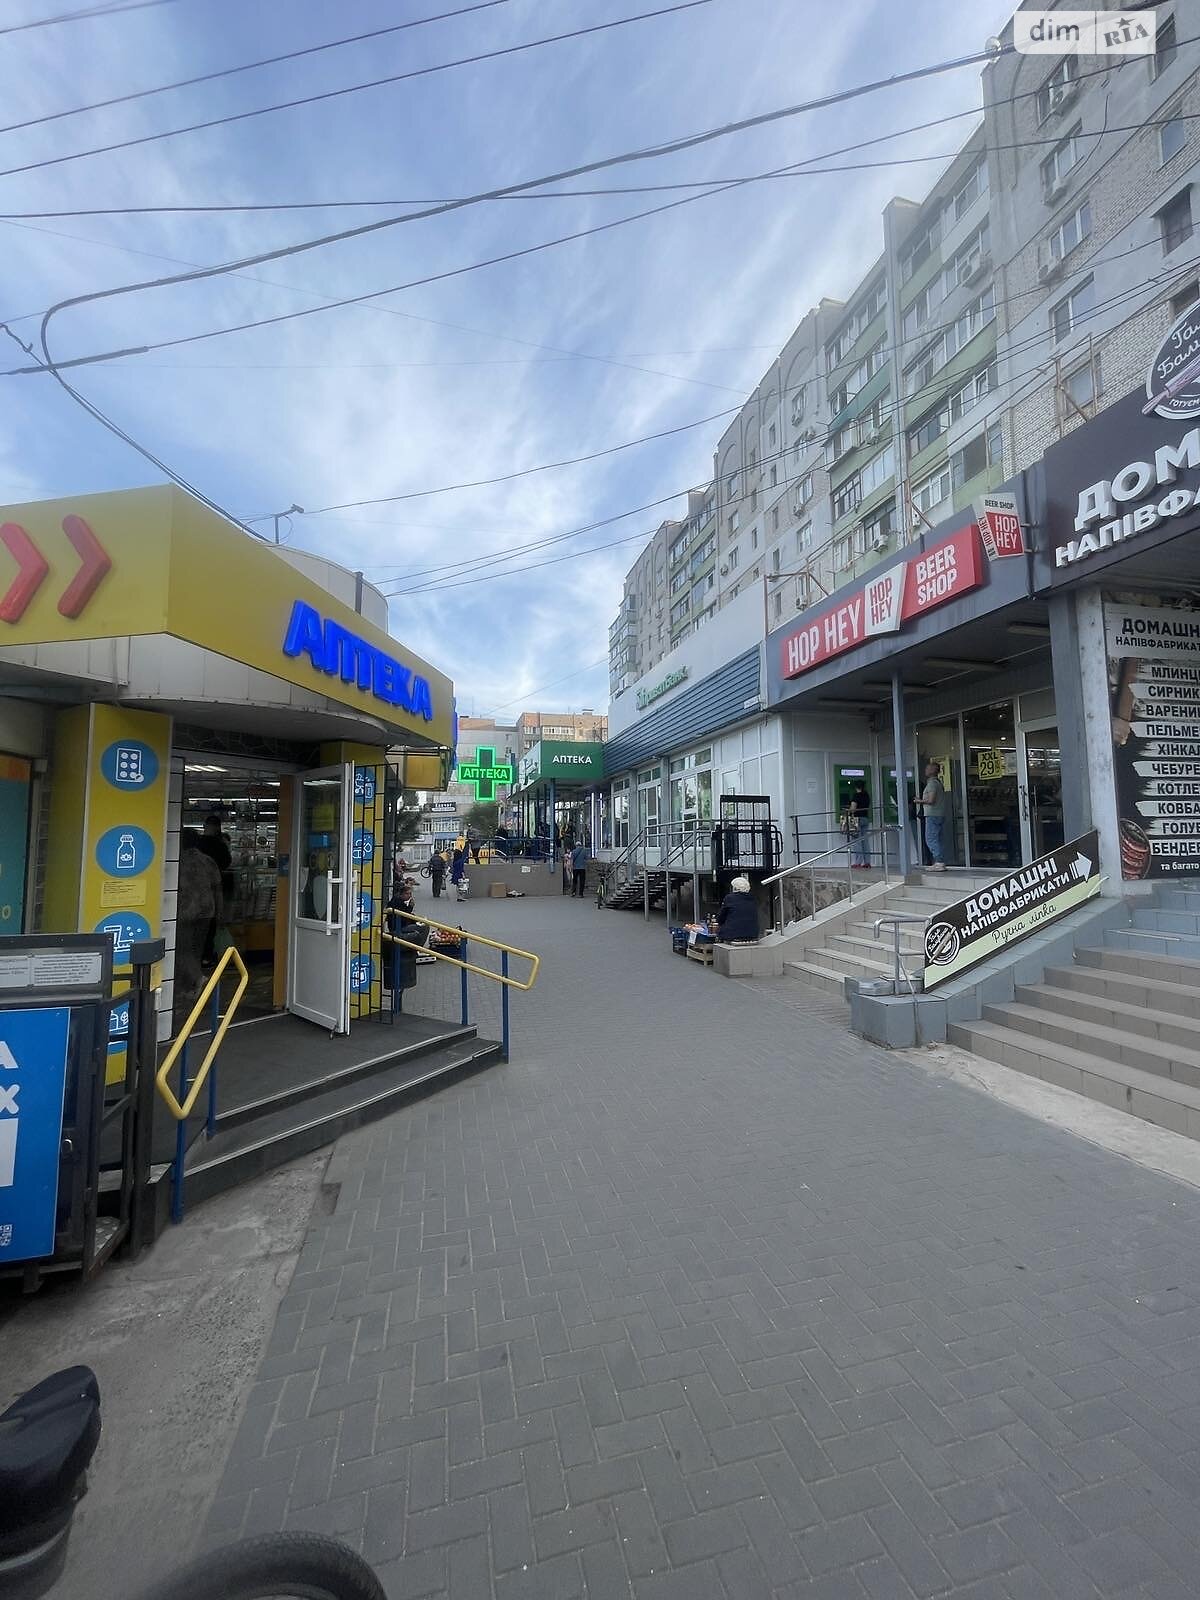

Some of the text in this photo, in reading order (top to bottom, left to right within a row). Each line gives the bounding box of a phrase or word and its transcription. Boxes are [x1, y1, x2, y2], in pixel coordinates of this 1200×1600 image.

[984, 499, 1014, 509] BEER SHOP
[995, 515, 1017, 533] HOP
[996, 532, 1017, 549] HEY
[916, 544, 956, 584] BEER
[869, 576, 892, 604] HOP
[917, 568, 957, 606] SHOP
[870, 596, 892, 626] HEY
[788, 600, 861, 672] HOP HEY
[283, 599, 434, 721] АПТЕКА
[552, 755, 593, 765] АПТЕКА
[980, 760, 995, 776] 29
[982, 752, 998, 761] XXL
[463, 768, 508, 780] АПТЕКА
[1157, 783, 1200, 795] КОТЛЕ
[965, 858, 1058, 922] ДОМАШНІ
[960, 872, 1070, 939] НАПІВФАБРИКАТИ
[992, 920, 1026, 943] Ручна
